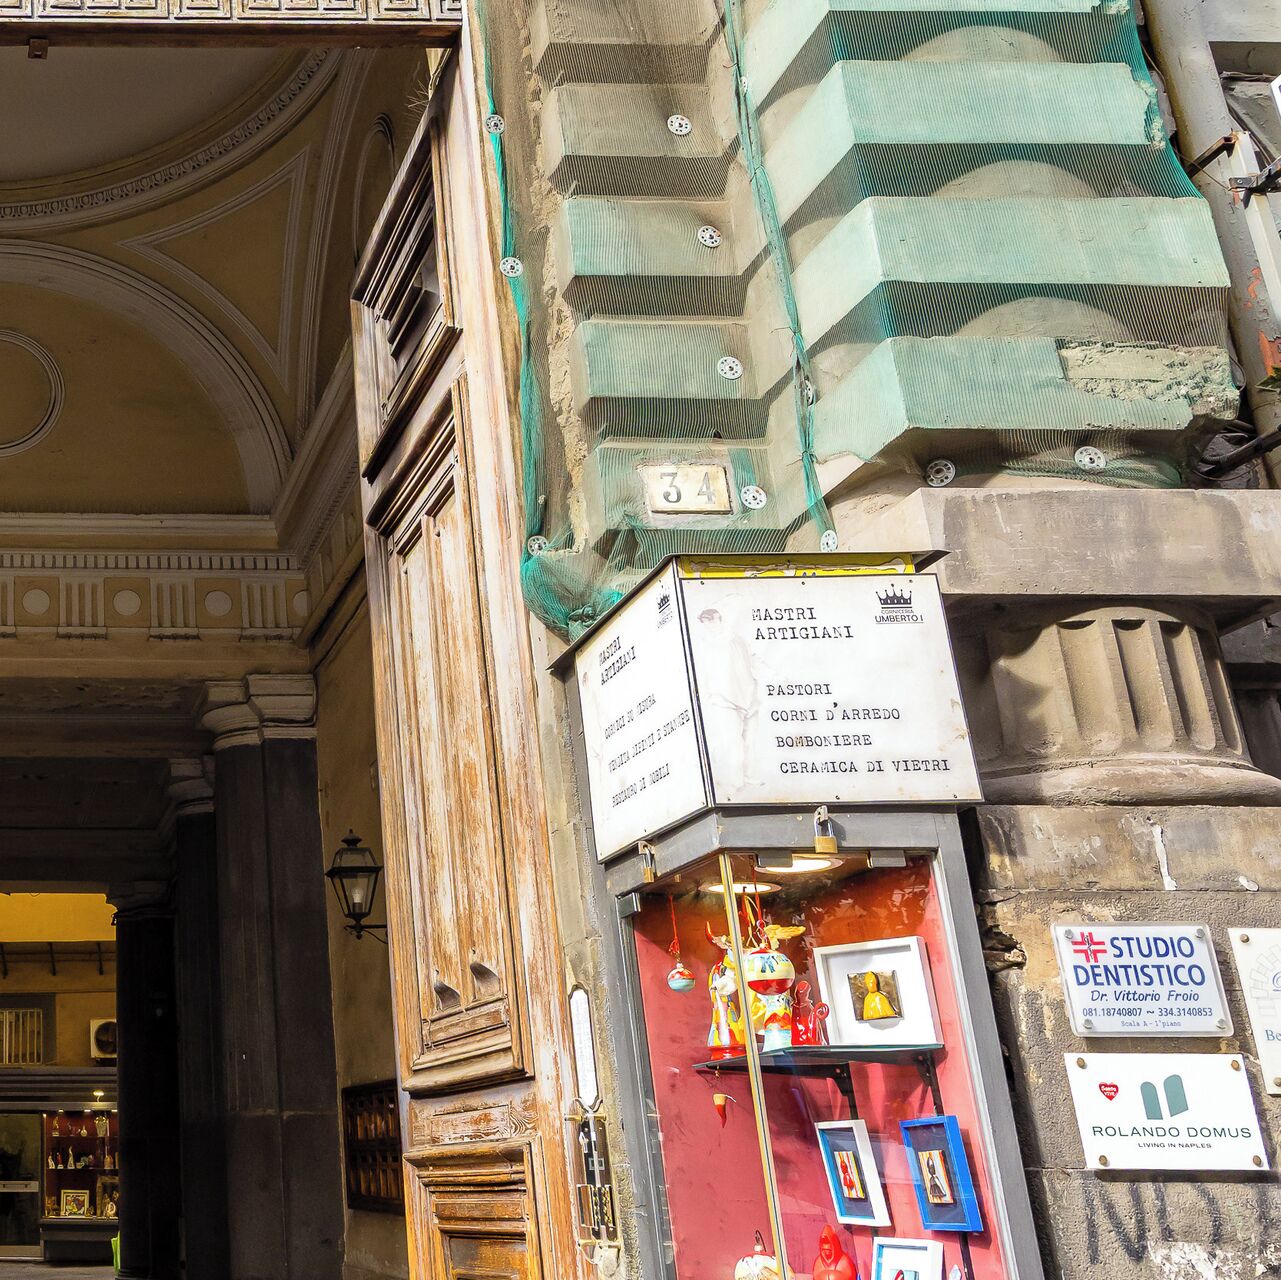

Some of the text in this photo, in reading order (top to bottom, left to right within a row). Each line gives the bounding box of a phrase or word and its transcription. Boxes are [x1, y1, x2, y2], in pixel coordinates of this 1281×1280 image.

[660, 471, 716, 505] 34
[752, 607, 817, 621] MASTRI
[755, 625, 854, 641] ARTIGIANI
[599, 636, 621, 666] MASTRI
[766, 683, 832, 696] PASTORI
[771, 702, 900, 723] CORNI D'ARREDO
[776, 734, 872, 748] BOMBONIERE
[780, 759, 950, 774] CERAMICA DI VIETRI
[1110, 936, 1195, 958] STUDIO
[1073, 964, 1206, 986] DENTISTICO
[1091, 989, 1200, 1002] Dr. Vittorio Froio
[1082, 1007, 1142, 1017] 081.18740807
[1158, 1007, 1213, 1017] 334.3140853
[1092, 1126, 1252, 1138] ROLANDO DOMUS
